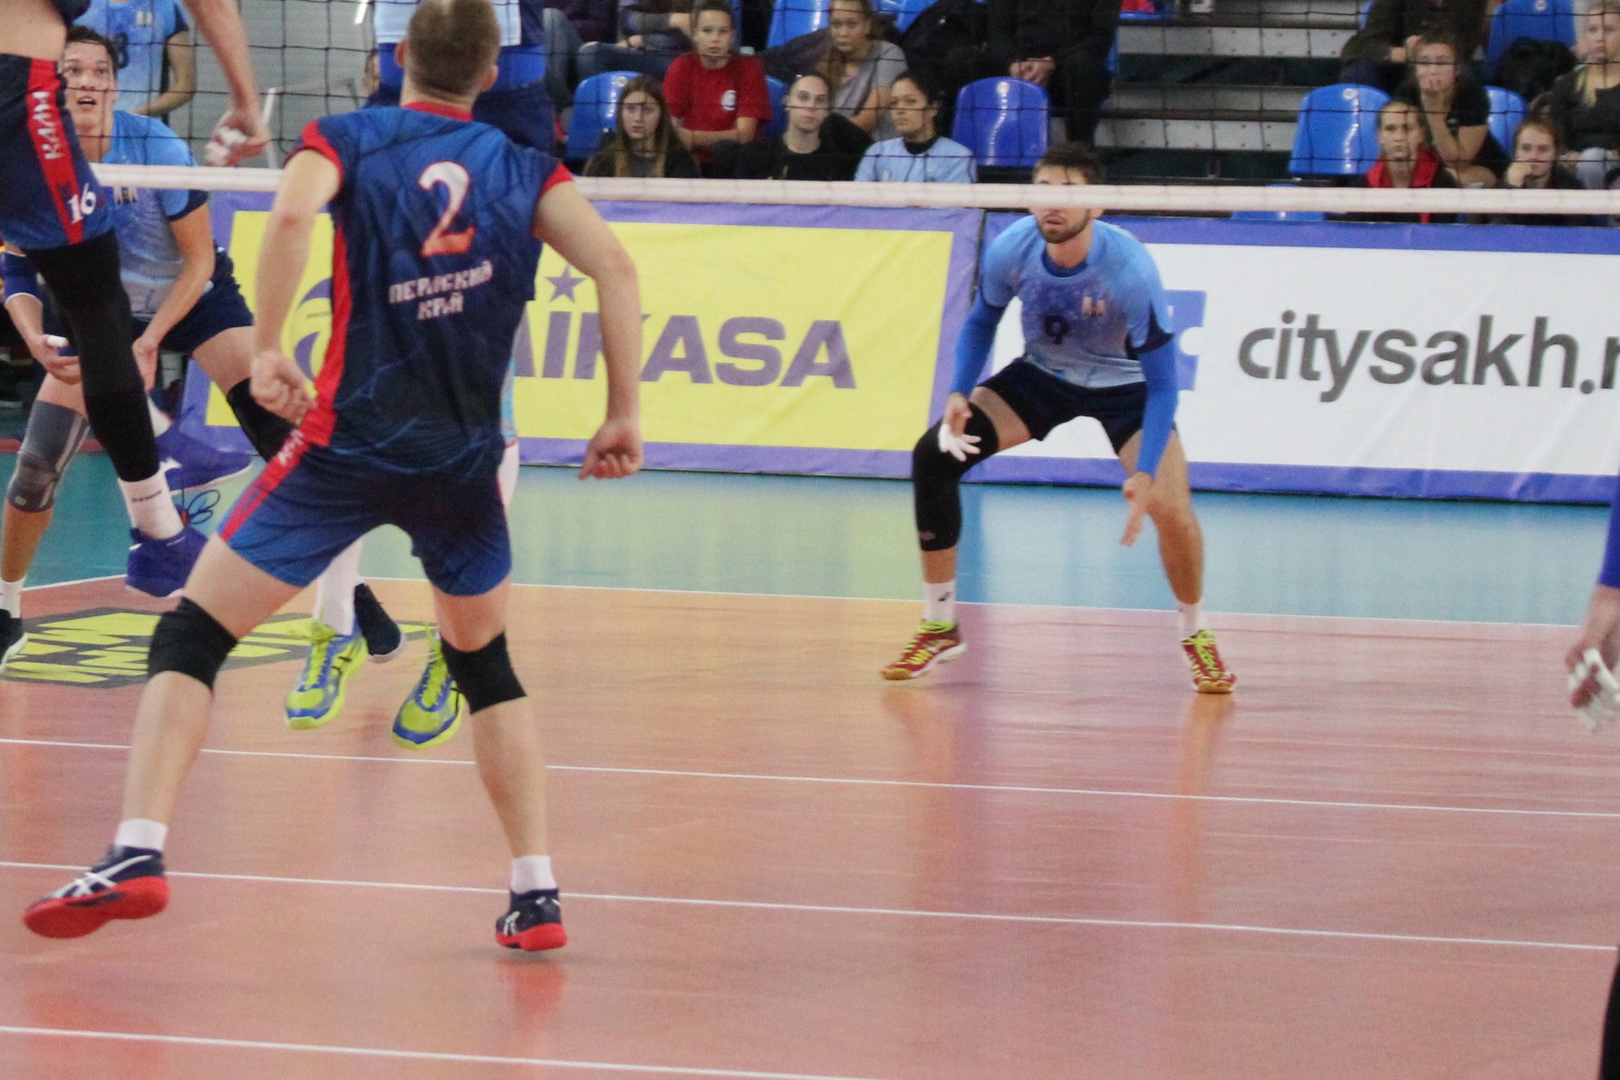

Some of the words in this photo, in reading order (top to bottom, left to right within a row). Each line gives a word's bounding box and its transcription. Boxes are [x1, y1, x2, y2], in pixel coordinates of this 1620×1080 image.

[67, 182, 97, 225] 16
[417, 159, 477, 258] 2
[1043, 313, 1071, 346] 9
